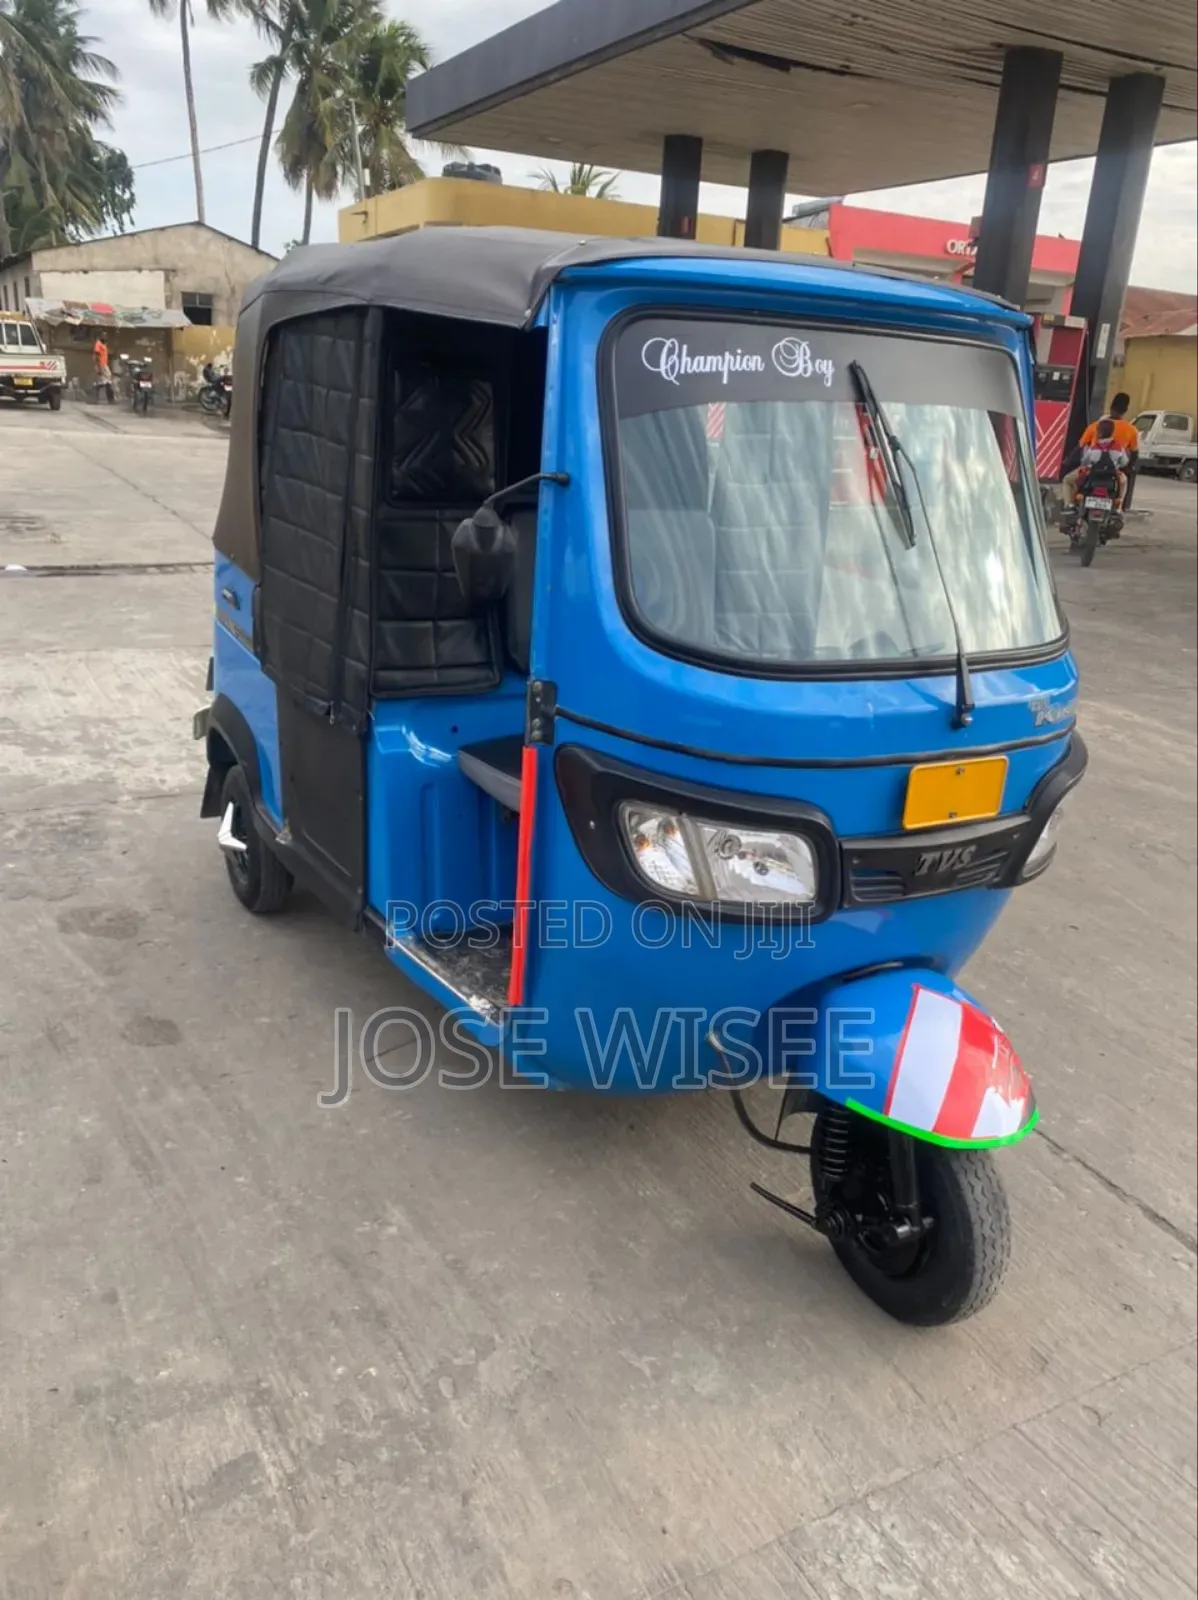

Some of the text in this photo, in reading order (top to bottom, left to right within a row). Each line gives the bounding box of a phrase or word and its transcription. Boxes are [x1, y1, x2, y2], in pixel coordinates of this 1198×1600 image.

[641, 336, 834, 387] Champion Boy
[914, 845, 977, 876] TVS
